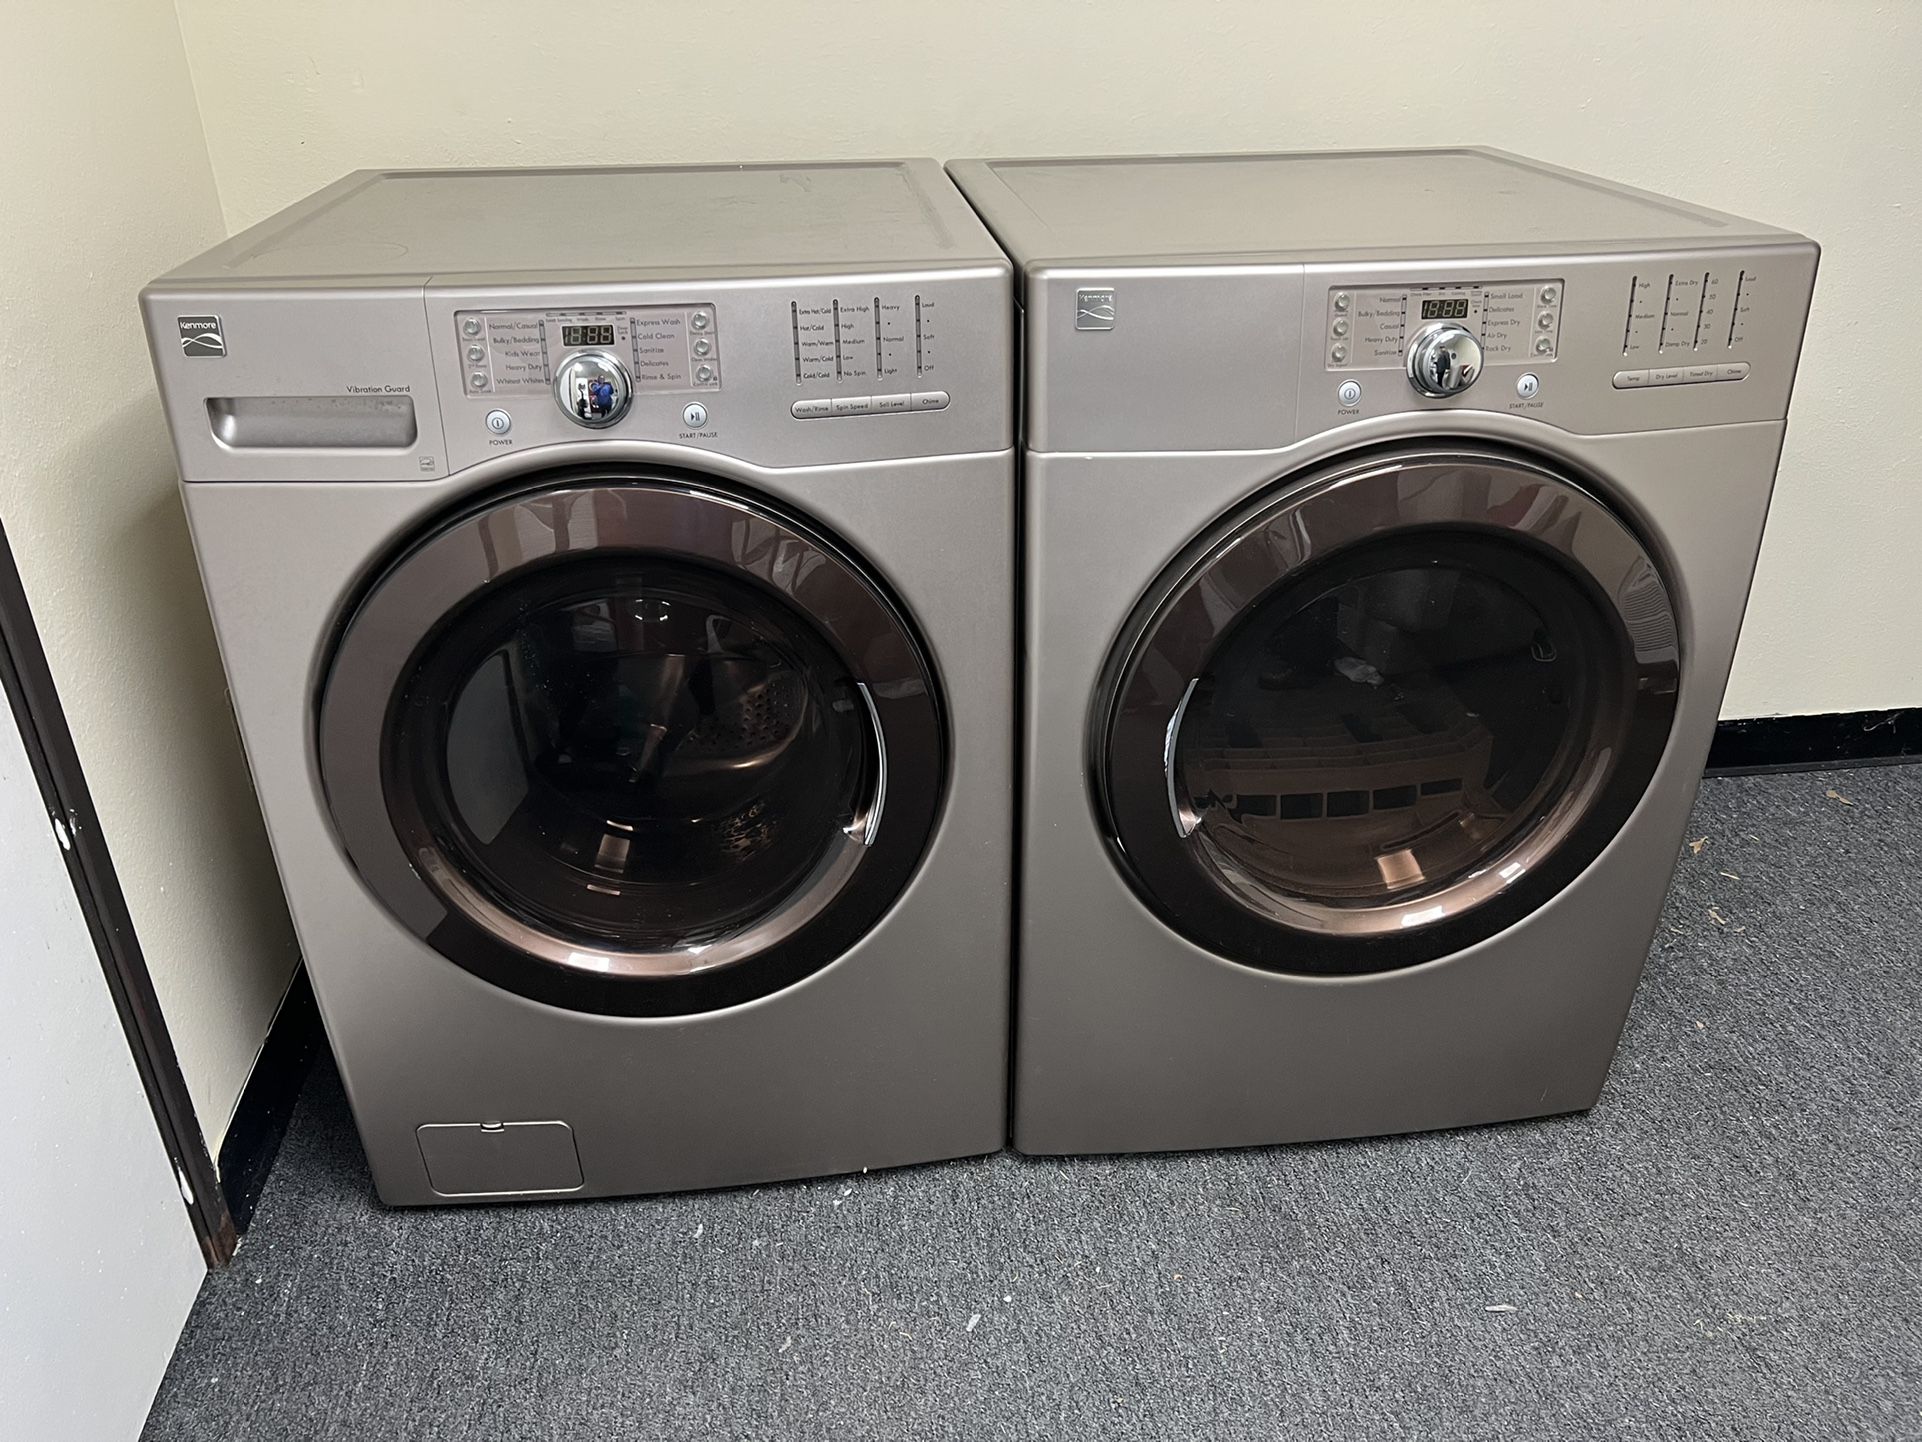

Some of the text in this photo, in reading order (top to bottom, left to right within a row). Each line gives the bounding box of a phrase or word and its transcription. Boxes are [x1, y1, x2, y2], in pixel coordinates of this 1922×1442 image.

[882, 304, 900, 312] Heavy
[180, 321, 216, 330] Kenmore
[493, 337, 540, 345] Bulky/Bedding
[384, 384, 410, 392] Guard
[1509, 402, 1544, 410] START/PAUSE
